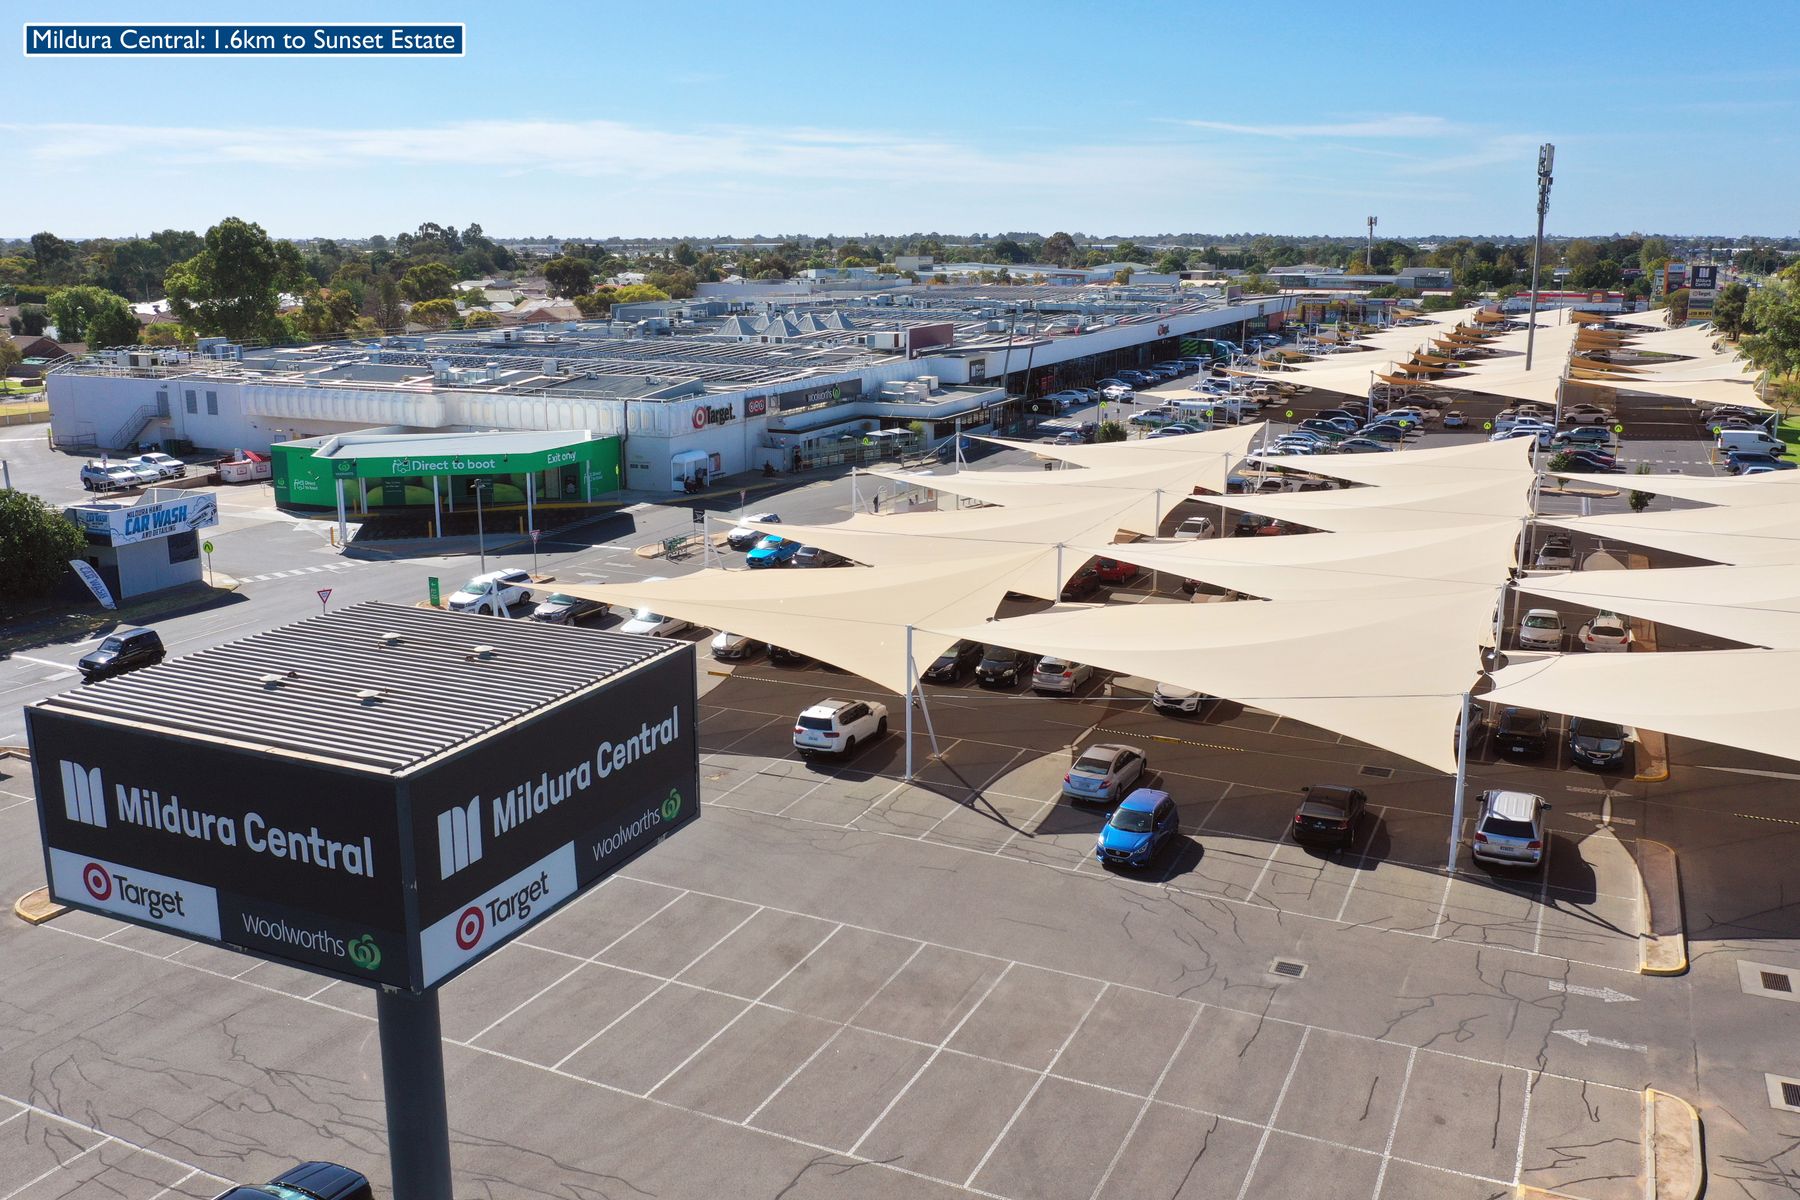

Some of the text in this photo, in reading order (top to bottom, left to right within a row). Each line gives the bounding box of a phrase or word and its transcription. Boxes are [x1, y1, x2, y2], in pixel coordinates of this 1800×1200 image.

[412, 459, 496, 471] Direct to boot
[547, 451, 577, 464] Exit only
[125, 505, 188, 536] CAR WASH
[126, 507, 149, 519] MILDURA
[141, 525, 177, 540] AND DETAILING
[90, 578, 109, 600] WASH
[493, 705, 680, 838] Mildura Central
[115, 783, 375, 878] Mildura Central
[592, 808, 661, 862] Woolworths
[112, 874, 185, 920] Target
[485, 870, 549, 920] Target
[241, 912, 346, 958] Woolworths
